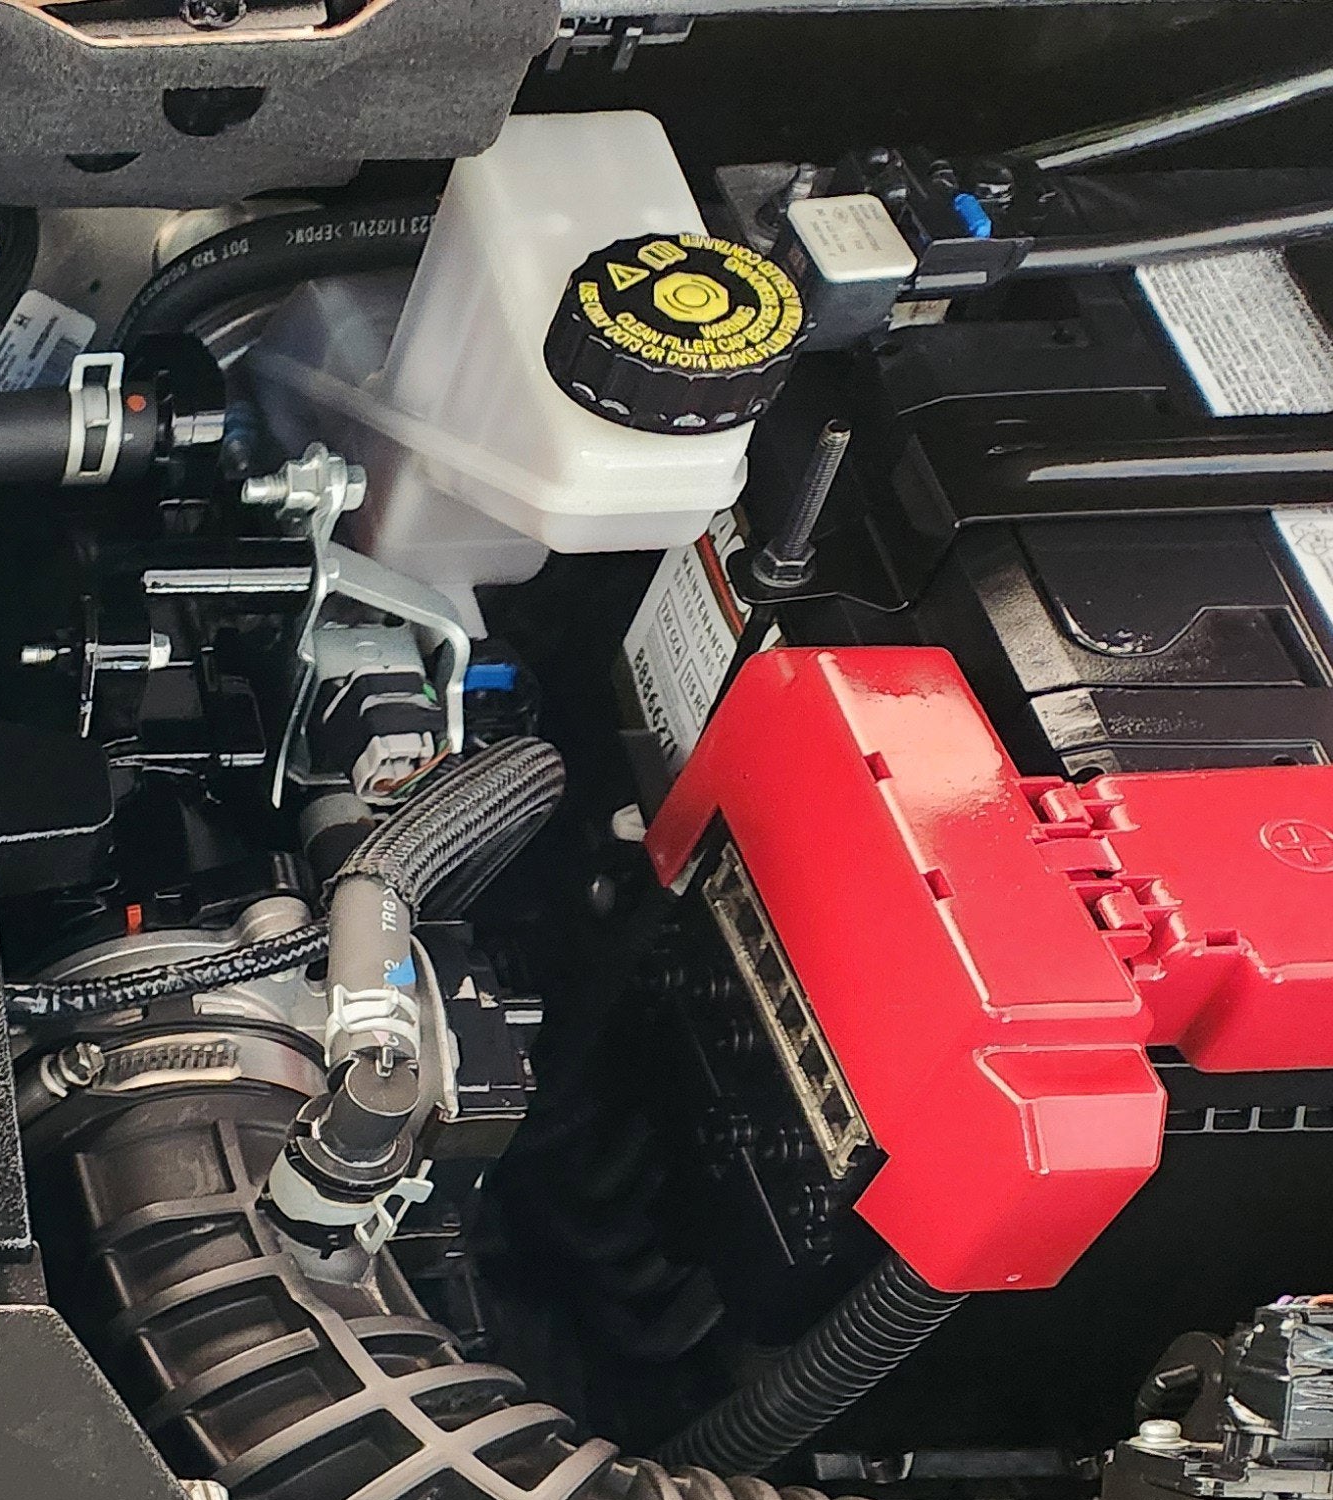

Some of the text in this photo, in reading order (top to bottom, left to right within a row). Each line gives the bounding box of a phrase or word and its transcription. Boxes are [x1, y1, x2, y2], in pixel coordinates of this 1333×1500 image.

[679, 234, 763, 266] CONTAINER
[615, 312, 663, 345] CLEAN
[661, 334, 717, 355] FILLER
[716, 333, 746, 353] CAP
[698, 304, 757, 340] WARNING
[604, 325, 643, 353] DOT3
[641, 343, 665, 363] OR
[709, 347, 764, 370] BRAKE
